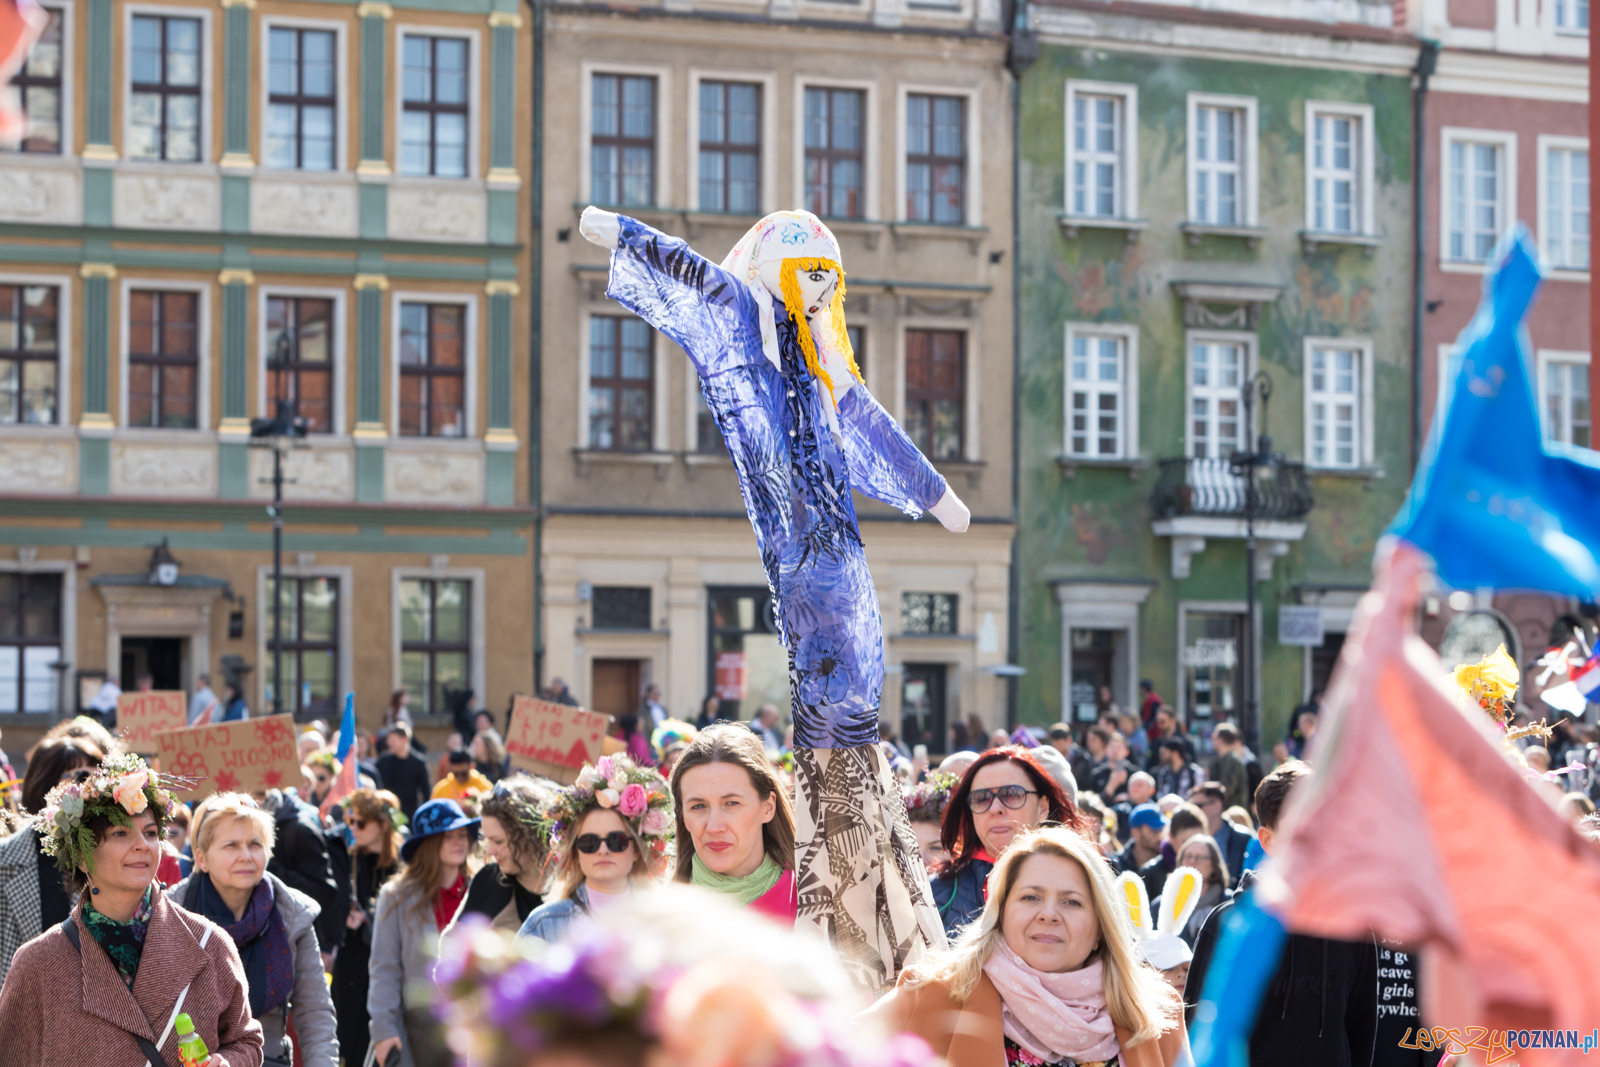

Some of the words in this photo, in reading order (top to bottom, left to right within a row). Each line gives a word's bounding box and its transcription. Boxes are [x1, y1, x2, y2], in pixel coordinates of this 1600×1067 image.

[119, 694, 183, 718] WITAJ
[160, 726, 231, 752] WITAJ
[221, 743, 293, 769] WIOSNO
[1377, 967, 1413, 980] eave
[1382, 982, 1415, 1001] girls
